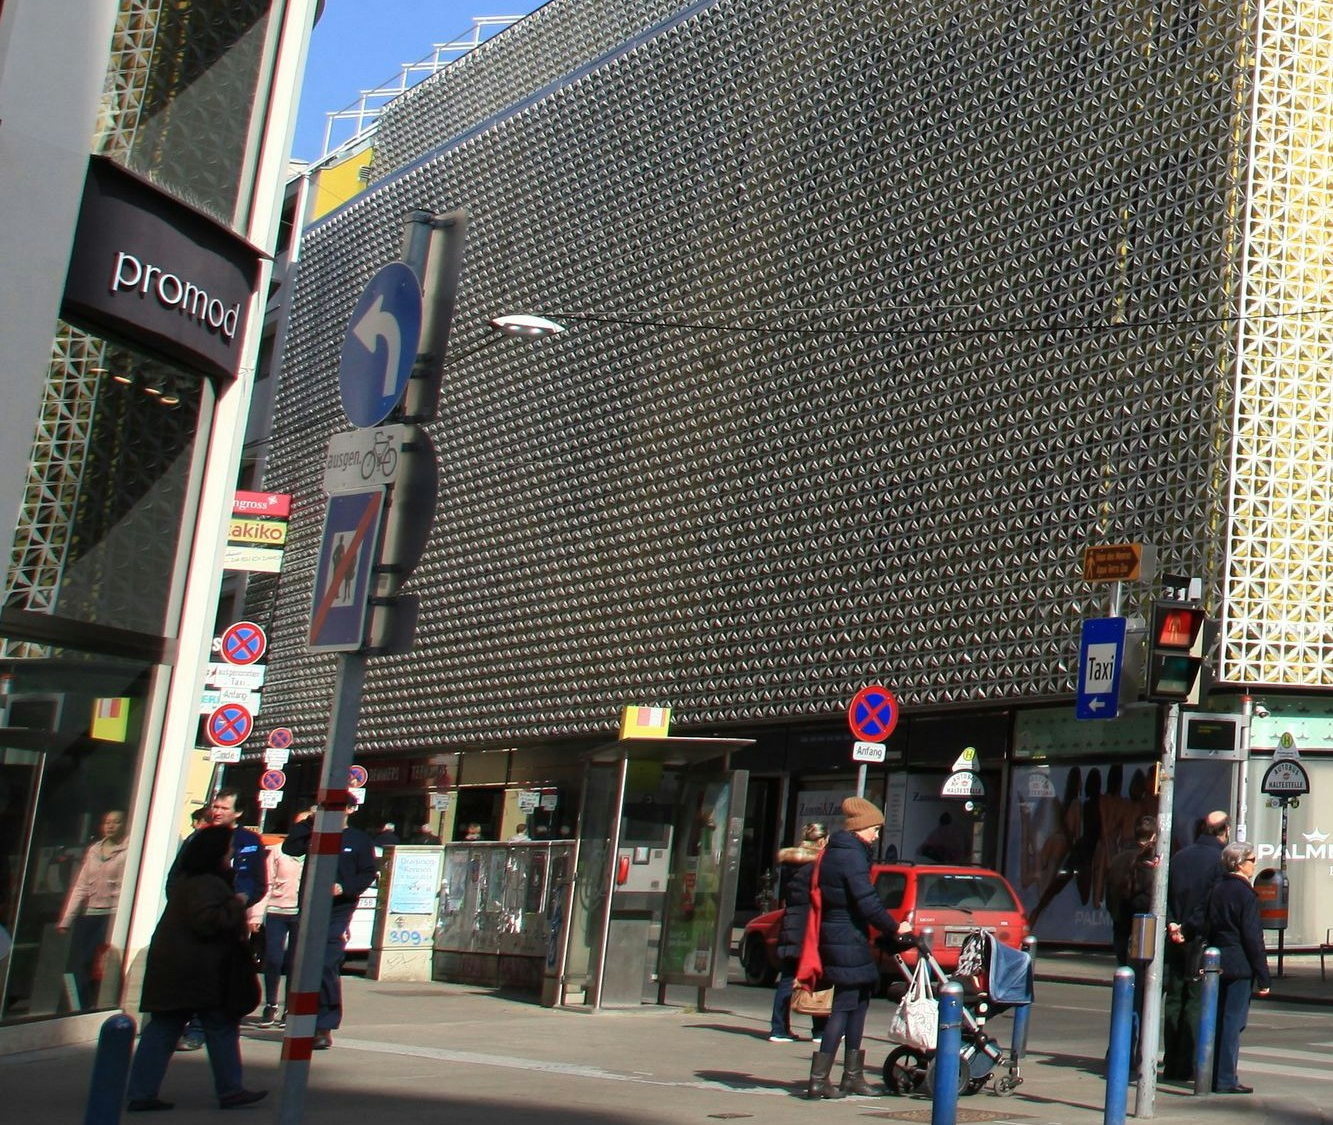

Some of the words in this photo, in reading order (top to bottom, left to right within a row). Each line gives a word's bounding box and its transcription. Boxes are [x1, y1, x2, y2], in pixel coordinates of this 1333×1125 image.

[112, 251, 240, 339] promod
[327, 449, 362, 472] ausgen.
[233, 499, 267, 510] ngross
[230, 523, 282, 540] akiko
[1089, 655, 1114, 681] Taxi
[857, 745, 883, 758] Anfang
[1268, 780, 1303, 789] HALTESTELLE
[1075, 910, 1113, 926] PALM
